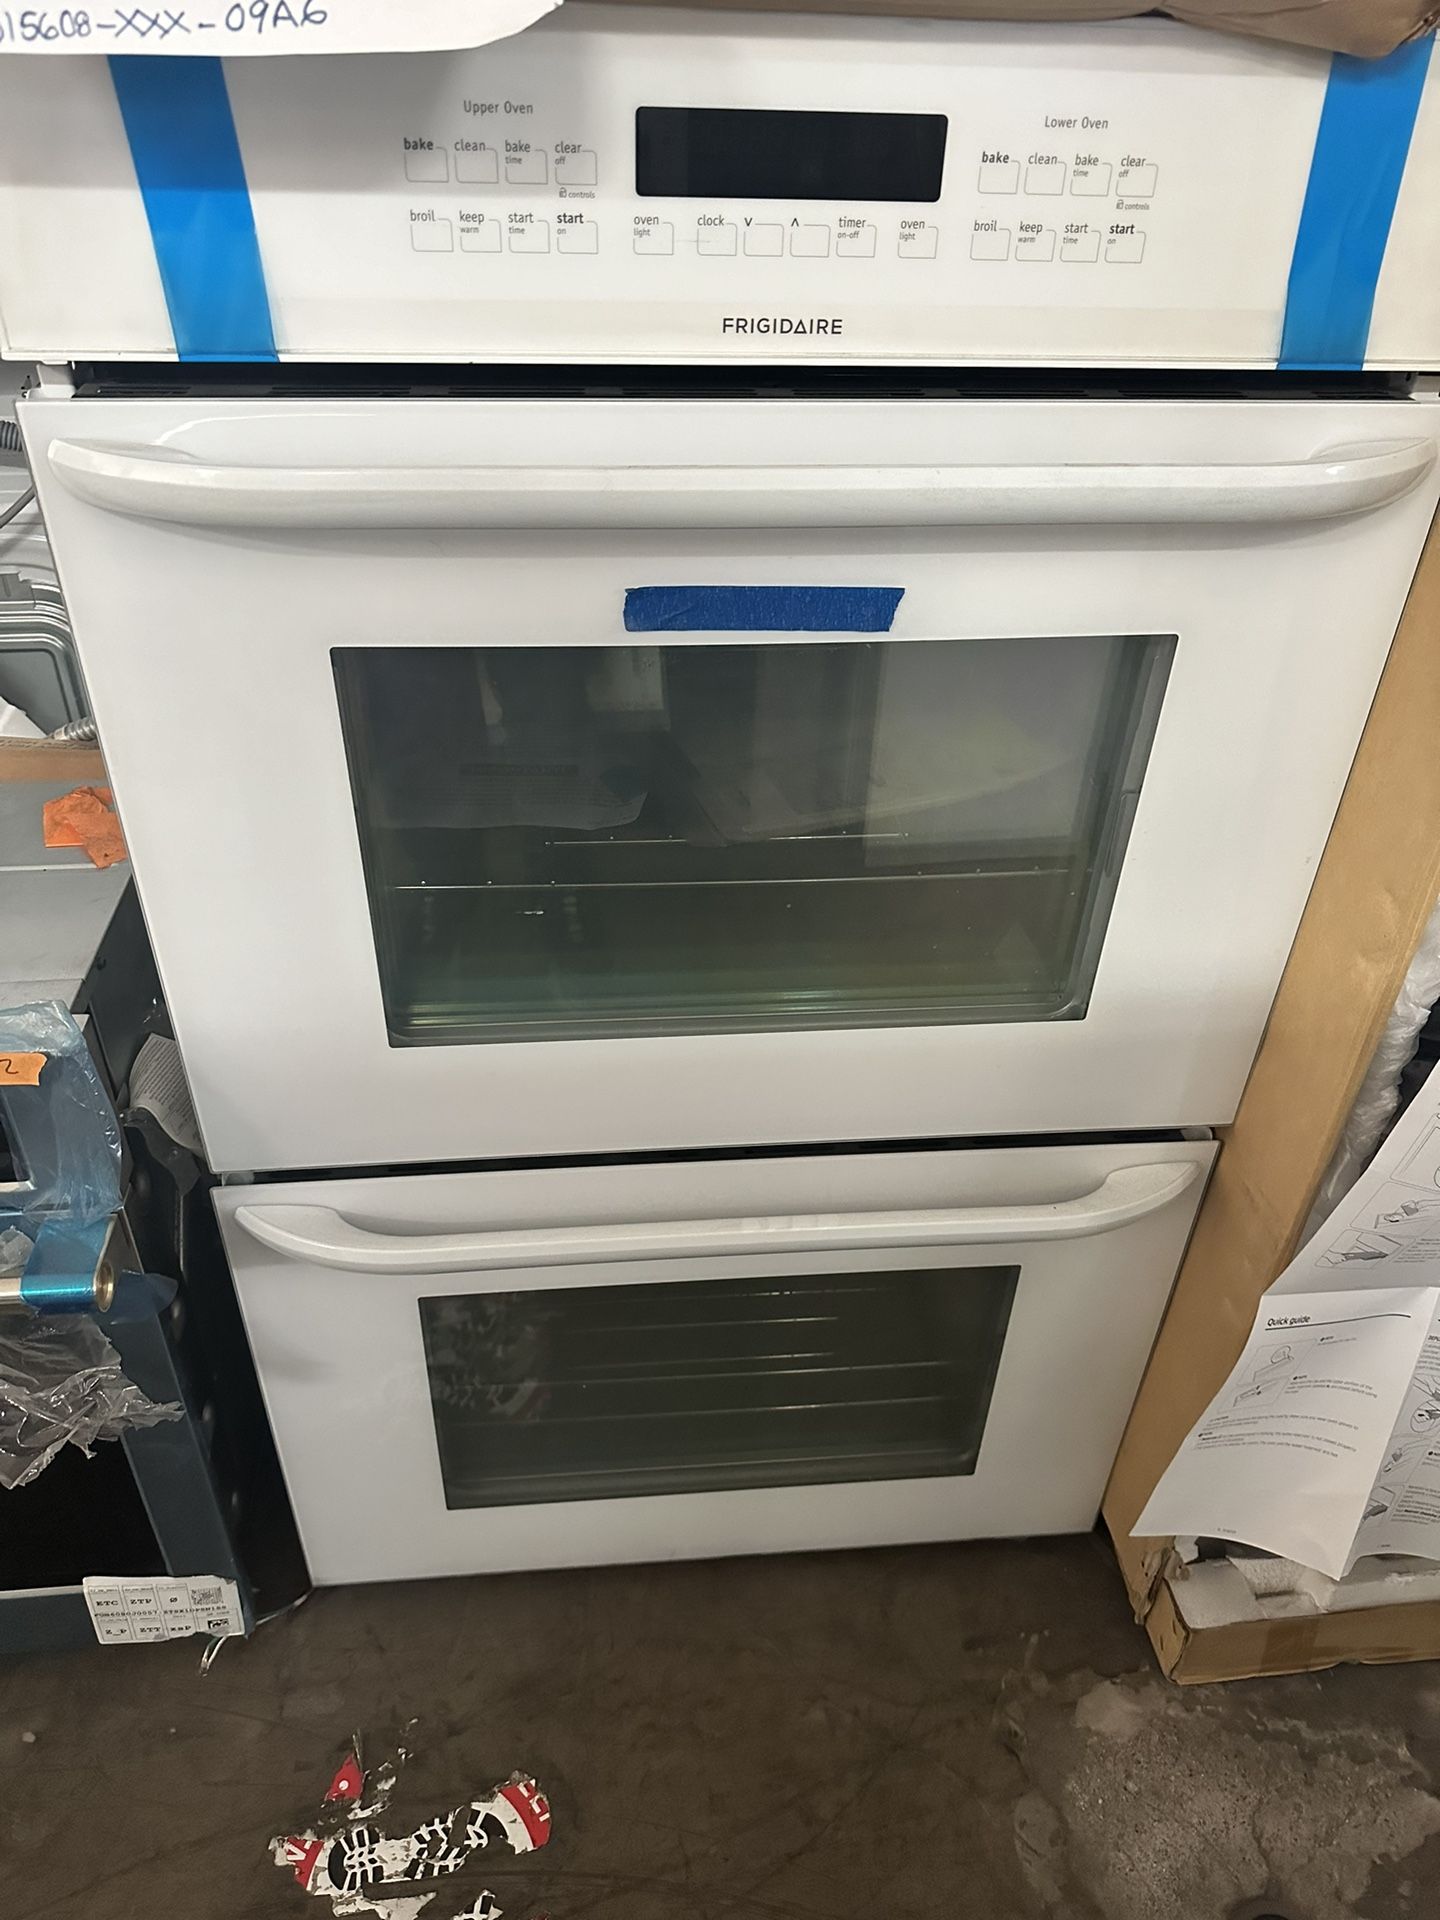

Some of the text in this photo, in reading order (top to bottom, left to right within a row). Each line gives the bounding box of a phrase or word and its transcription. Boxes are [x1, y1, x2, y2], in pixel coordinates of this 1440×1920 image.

[464, 100, 533, 116] Upper Oven
[1045, 116, 1108, 129] Lower Oven
[404, 138, 433, 150] bake
[455, 139, 485, 151] clean
[505, 140, 530, 152] bake
[555, 141, 582, 153] clear
[504, 155, 523, 165] time
[554, 155, 567, 166] off
[982, 151, 1009, 163] bake
[1028, 152, 1057, 164] clean
[1075, 154, 1099, 166] bake
[1121, 155, 1147, 167] clear
[1072, 168, 1089, 178] time
[1118, 168, 1130, 179] off
[567, 189, 596, 200] controls
[1124, 201, 1150, 211] controls
[410, 209, 435, 221] broil
[459, 211, 484, 225] keep
[508, 213, 534, 223] start
[557, 213, 584, 224] start
[633, 215, 660, 226] oven
[697, 214, 724, 226] clock
[839, 216, 866, 228] timer
[900, 220, 926, 230] oven
[974, 220, 997, 232] broil
[459, 226, 480, 234] warm
[508, 225, 526, 235] time
[556, 227, 567, 236] on
[633, 227, 651, 239] light
[1020, 221, 1043, 235] keep
[1064, 223, 1089, 234] start
[1109, 224, 1134, 234] start
[837, 230, 861, 240] on-off
[898, 231, 916, 243] light
[1017, 235, 1036, 244] warm
[1062, 235, 1079, 245] time
[723, 318, 842, 334] FRIGIDAIRE
[1267, 1316, 1311, 1327] Quick guide
